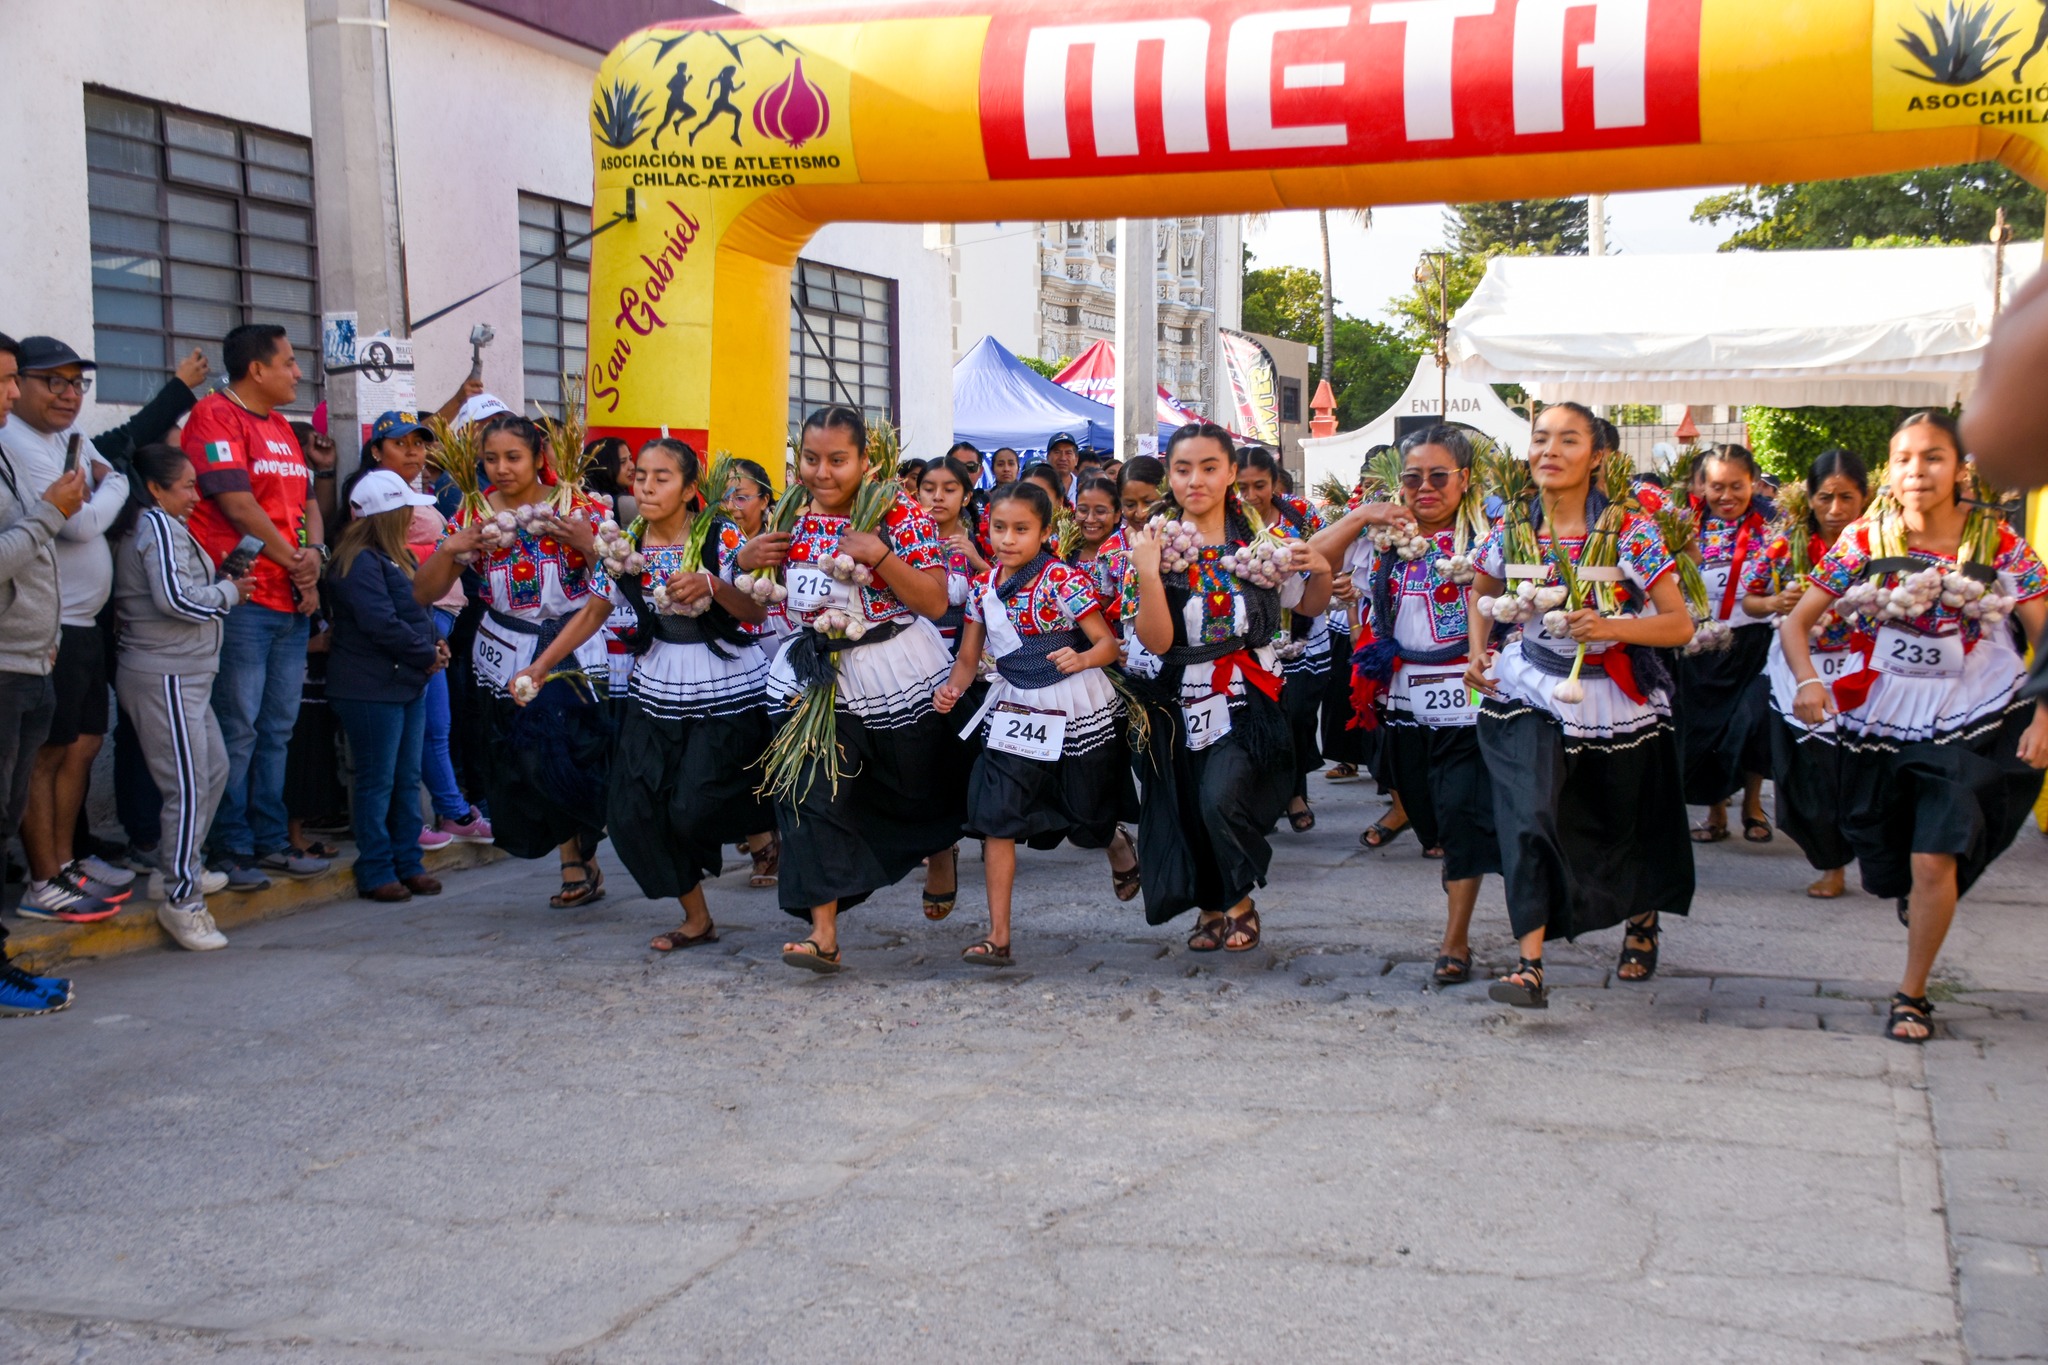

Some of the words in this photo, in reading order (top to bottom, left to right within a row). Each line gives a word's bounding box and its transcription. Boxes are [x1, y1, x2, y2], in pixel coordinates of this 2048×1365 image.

[1023, 0, 1649, 160] META
[601, 151, 695, 171] ASOCIACIÓN
[702, 156, 728, 170] DE
[734, 155, 840, 170] ATLETISMO
[632, 173, 795, 188] CHILAC-ATZINGO
[592, 337, 632, 413] San
[615, 200, 701, 336] Gabriel
[1412, 398, 1481, 413] ENTRADA
[797, 575, 833, 596] 215
[480, 640, 502, 668] 082
[1891, 638, 1941, 665] 233
[1425, 688, 1466, 709] 238
[1006, 720, 1047, 744] 244
[1187, 709, 1212, 734] 27
